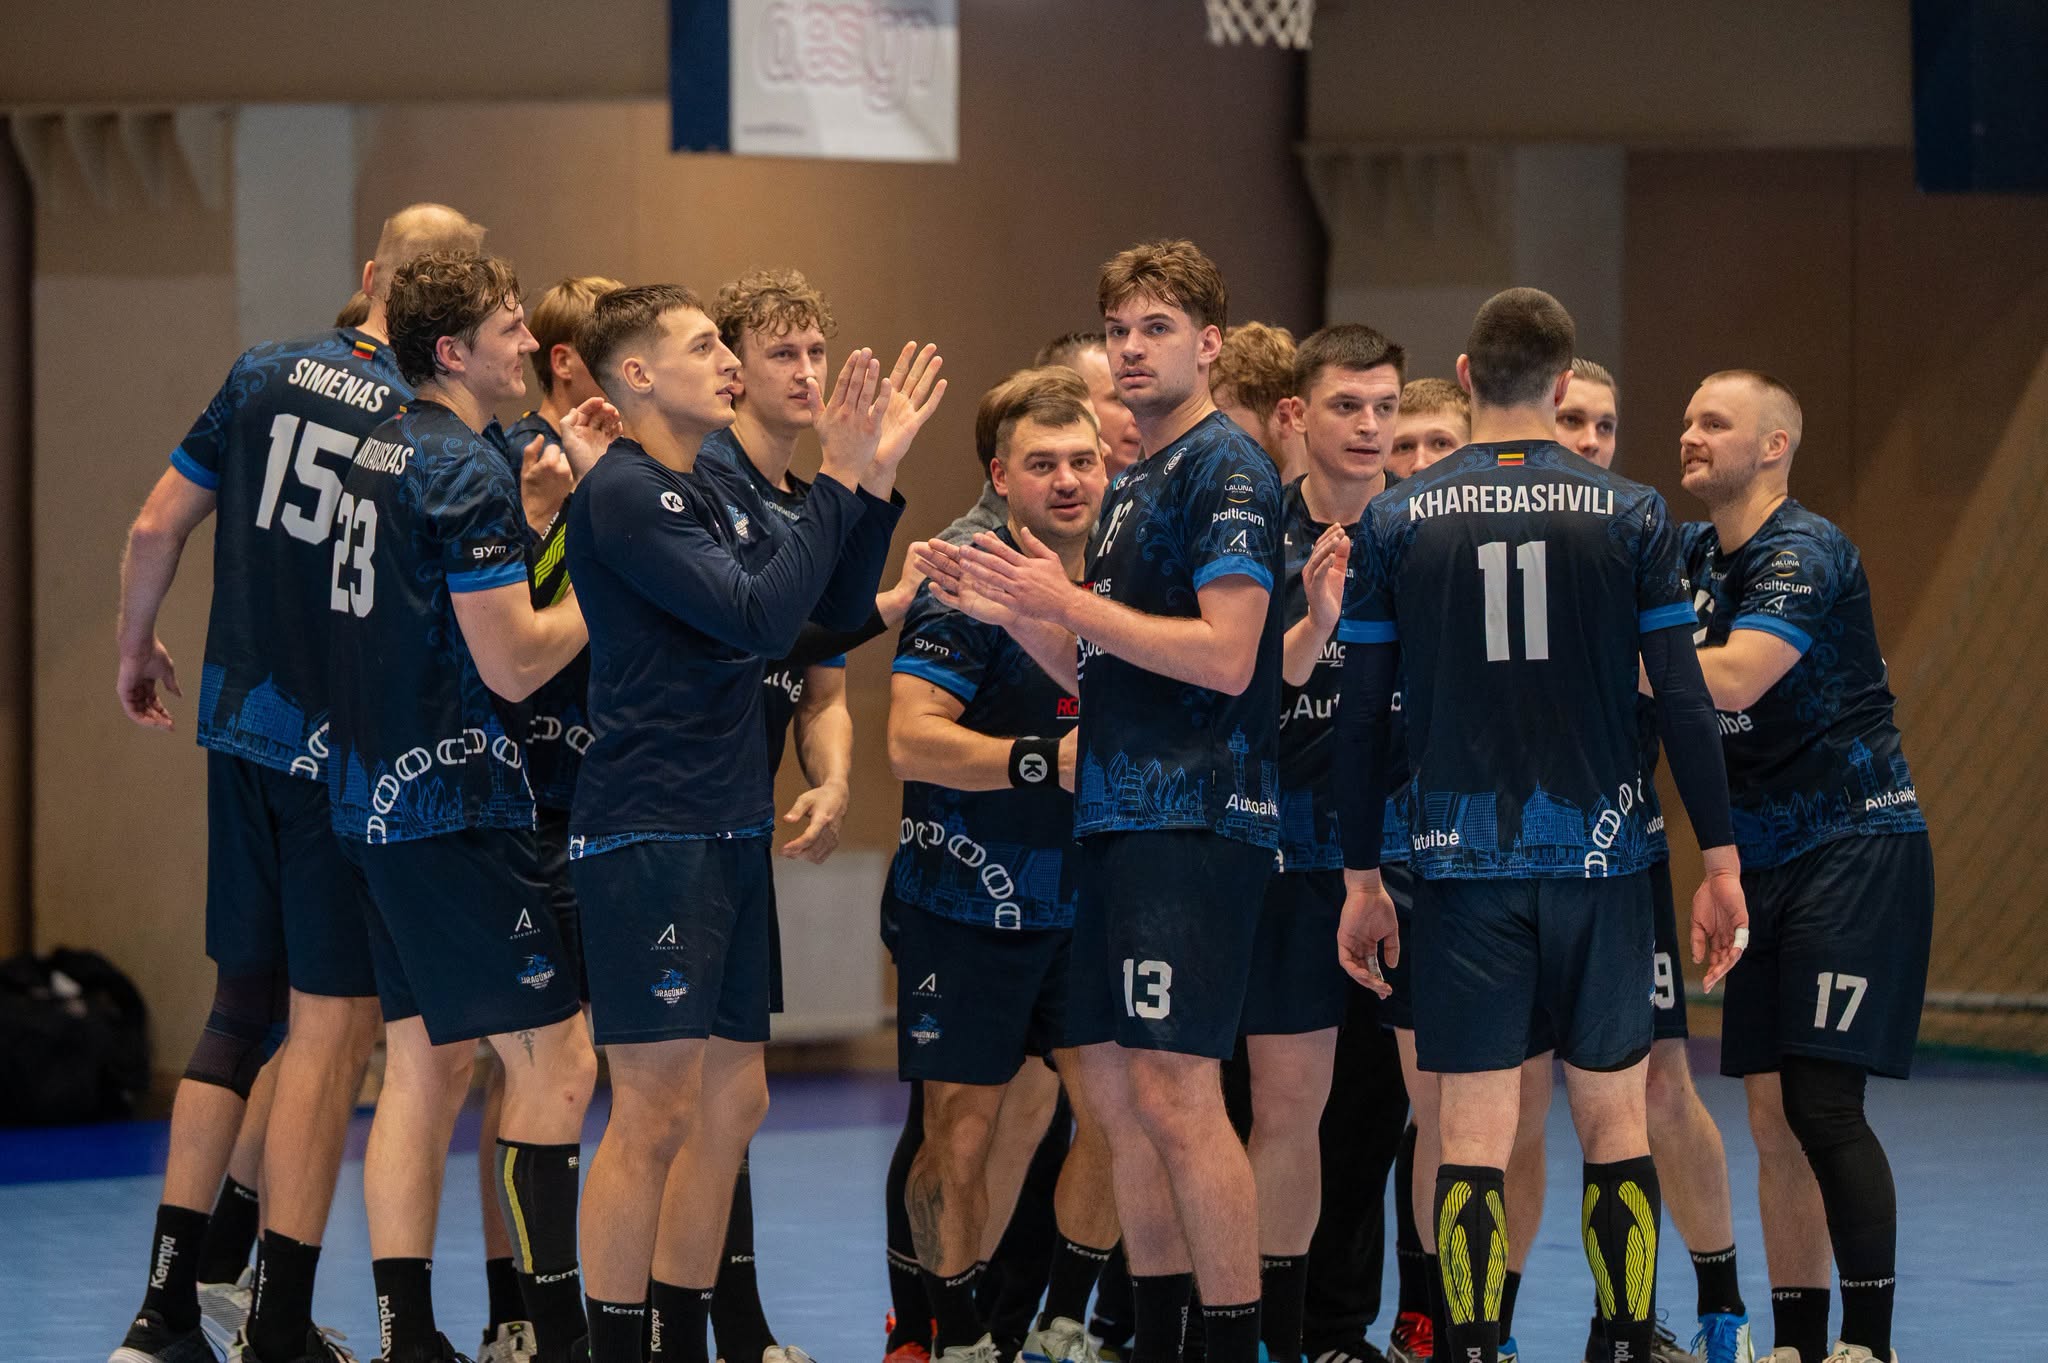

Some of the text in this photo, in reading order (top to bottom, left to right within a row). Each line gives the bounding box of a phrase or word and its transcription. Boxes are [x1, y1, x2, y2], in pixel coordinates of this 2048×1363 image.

[288, 358, 390, 413] SIMĖNAS
[255, 413, 360, 546] 15
[1409, 483, 1614, 521] KHAREBASHVILI
[1212, 507, 1265, 528] balticum
[330, 491, 378, 618] 23
[1478, 540, 1549, 662] 11
[1122, 957, 1173, 1020] 13
[1813, 971, 1869, 1033] 17
[150, 1234, 179, 1290] Kempa
[1840, 1276, 1895, 1289] Kempa
[651, 1308, 665, 1353] Kempa
